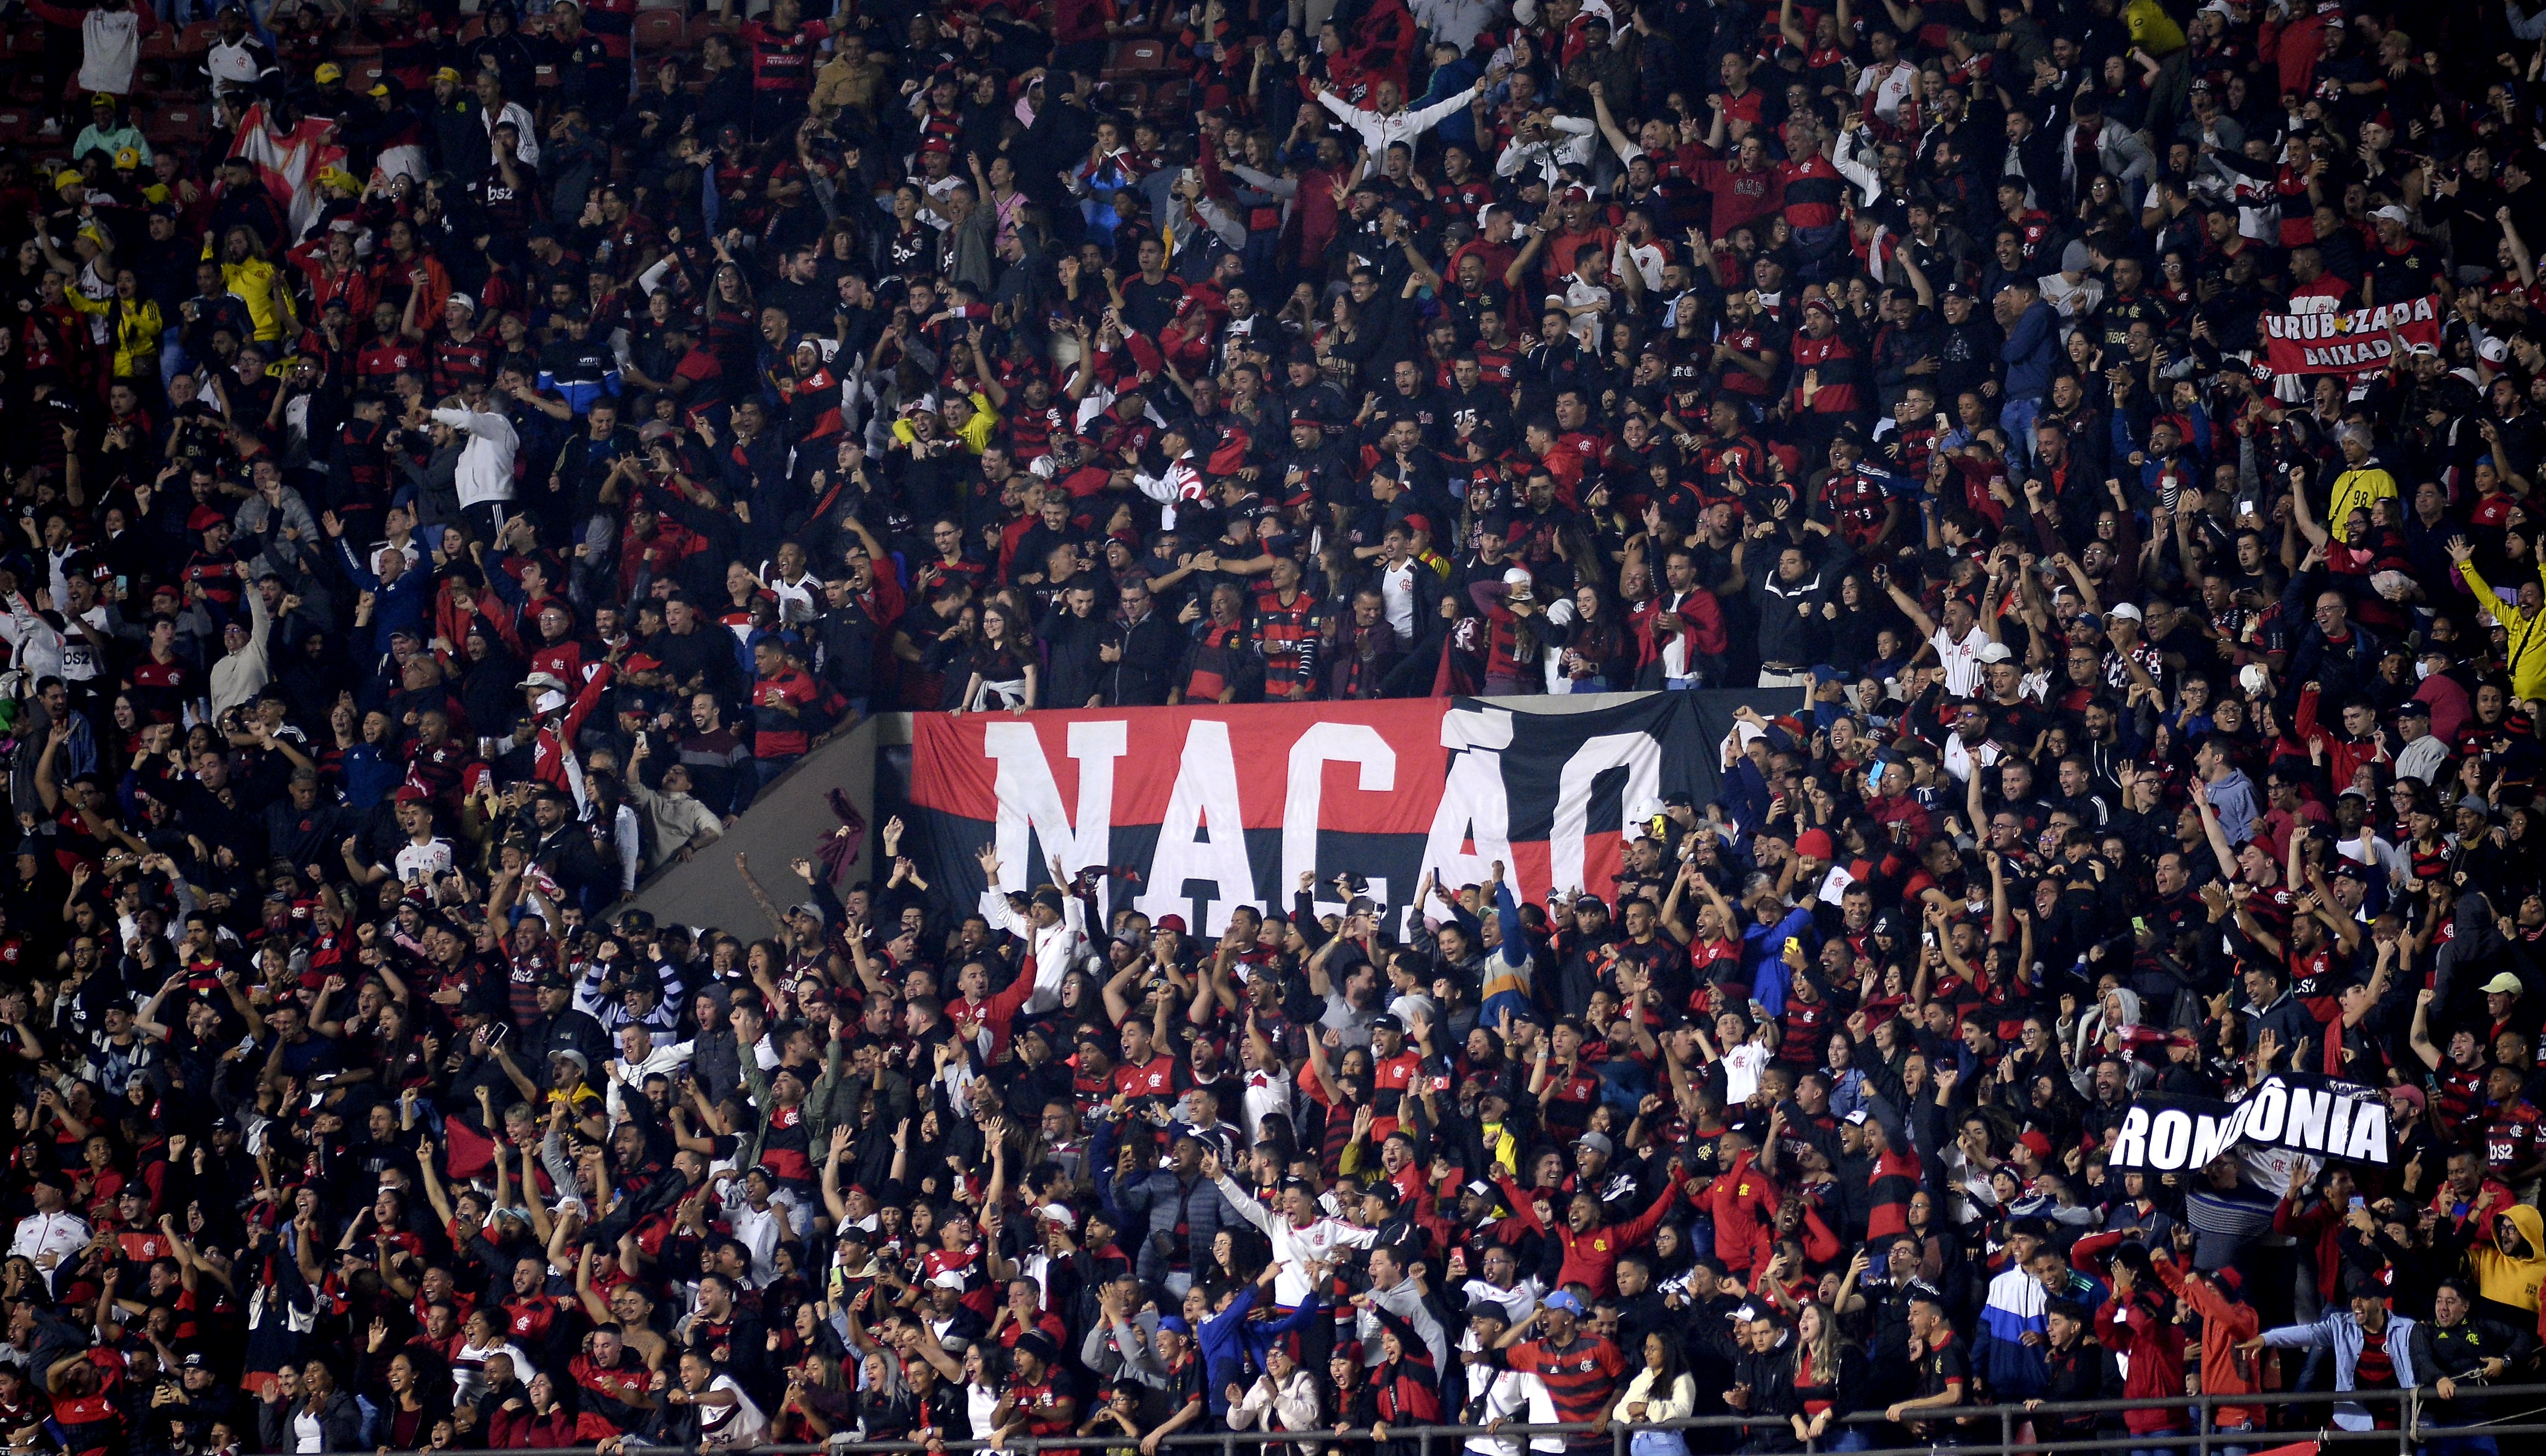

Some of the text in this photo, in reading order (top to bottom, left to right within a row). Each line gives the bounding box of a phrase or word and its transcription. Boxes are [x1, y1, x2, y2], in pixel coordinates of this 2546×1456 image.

[487, 186, 513, 202] bs2
[1734, 179, 1765, 198] GAP
[2353, 490, 2368, 505] 98
[512, 962, 534, 983] bs2
[2108, 1076, 2389, 1171] RONDÔNIA
[2489, 1140, 2513, 1160] bs2
